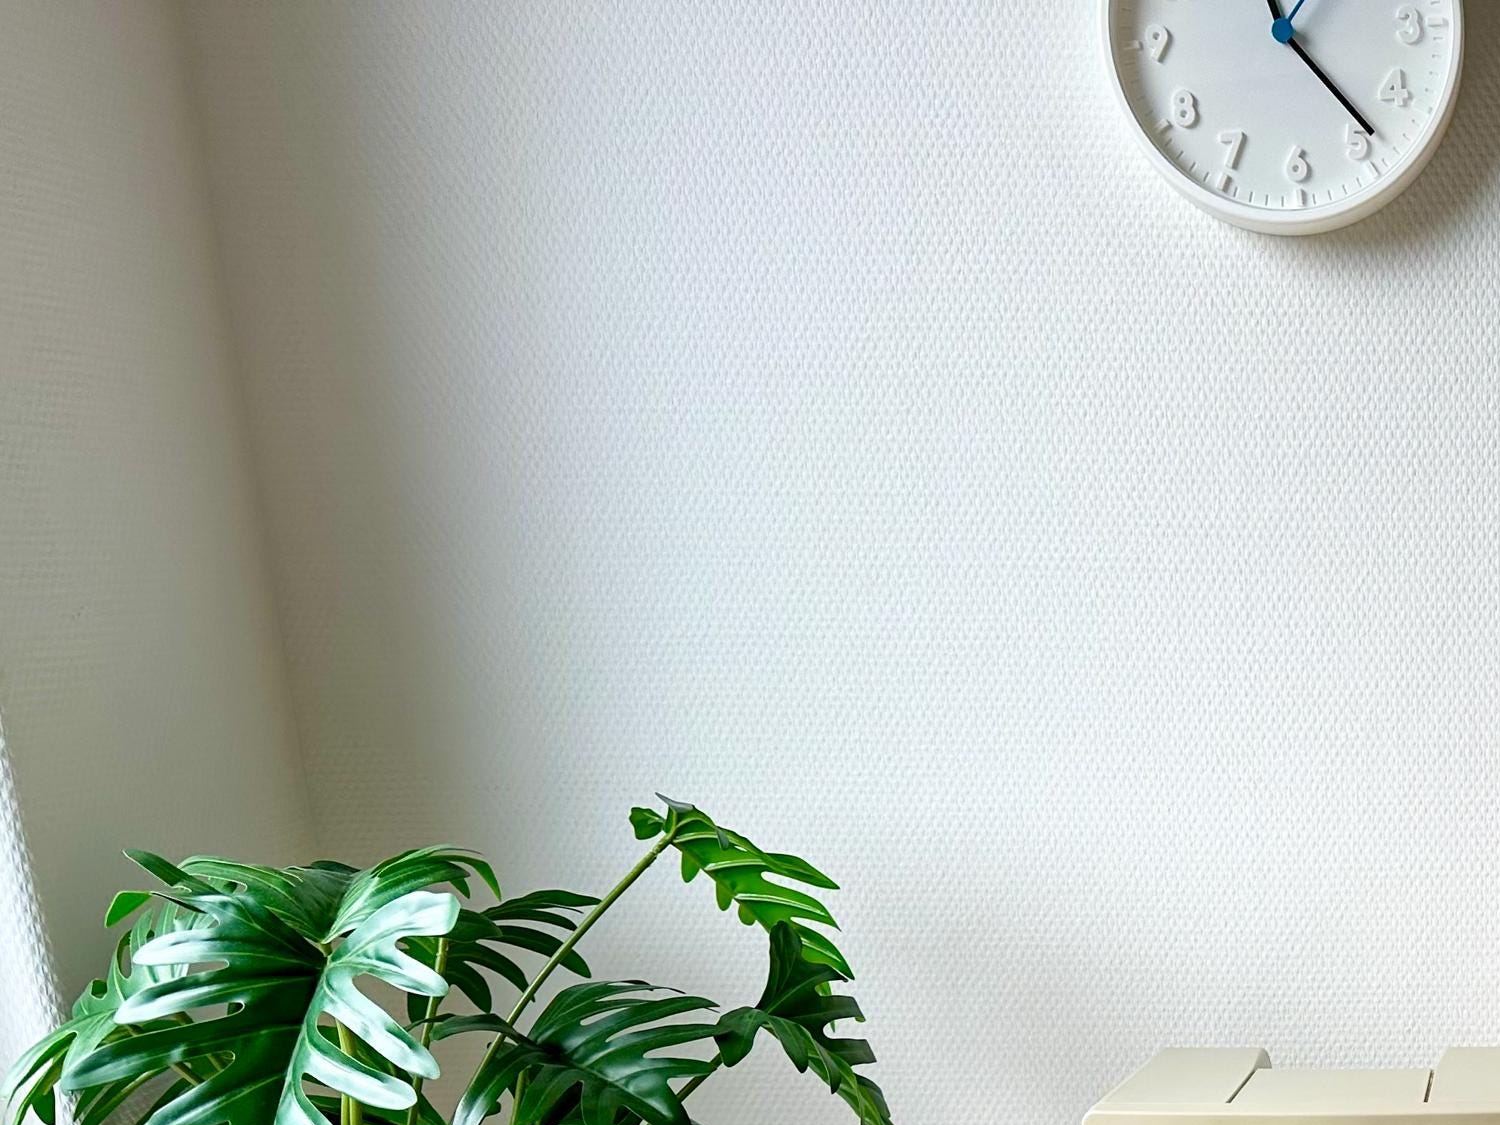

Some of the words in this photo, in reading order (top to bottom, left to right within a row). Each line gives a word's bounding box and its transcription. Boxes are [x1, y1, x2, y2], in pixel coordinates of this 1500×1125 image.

[1145, 24, 1170, 62] 9
[1396, 7, 1423, 44] 3
[1378, 68, 1410, 107] 4
[1172, 88, 1198, 128] 8
[1217, 130, 1247, 170] 7
[1345, 122, 1371, 160] 5
[1286, 146, 1311, 182] 6
